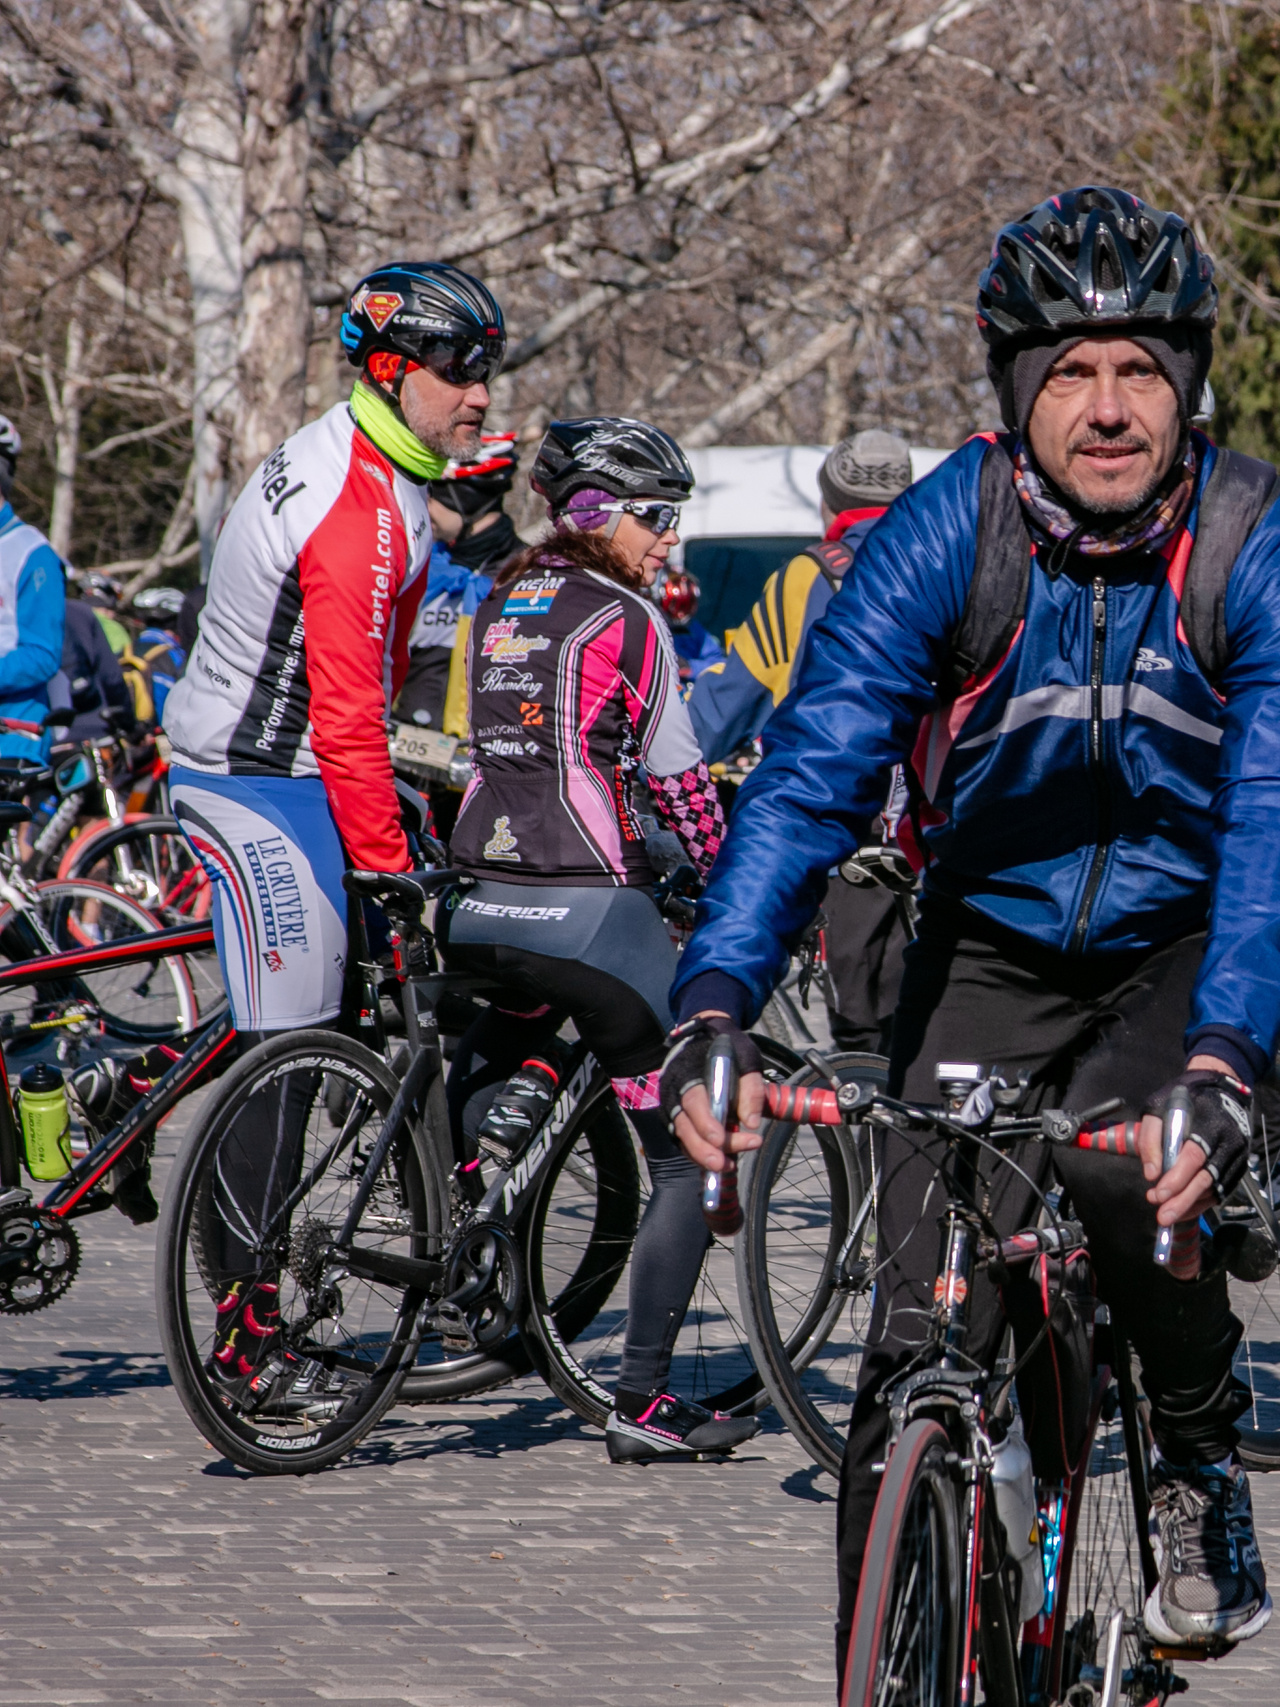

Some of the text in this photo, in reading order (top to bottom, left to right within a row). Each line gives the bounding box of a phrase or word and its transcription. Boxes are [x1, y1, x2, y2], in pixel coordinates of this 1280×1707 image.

[368, 507, 392, 640] hertel.com
[423, 612, 459, 626] CRA
[477, 666, 544, 699] Rhomberg
[255, 696, 290, 751] Perform,
[396, 738, 430, 756] 205
[244, 845, 277, 944] SWITZERLAND
[256, 835, 310, 948] LE GRUYÈRE
[459, 897, 571, 921] MERIDA
[319, 1056, 375, 1089] SUPER
[542, 1314, 616, 1406] SUPER AER
[255, 1431, 322, 1450] MERIDA
